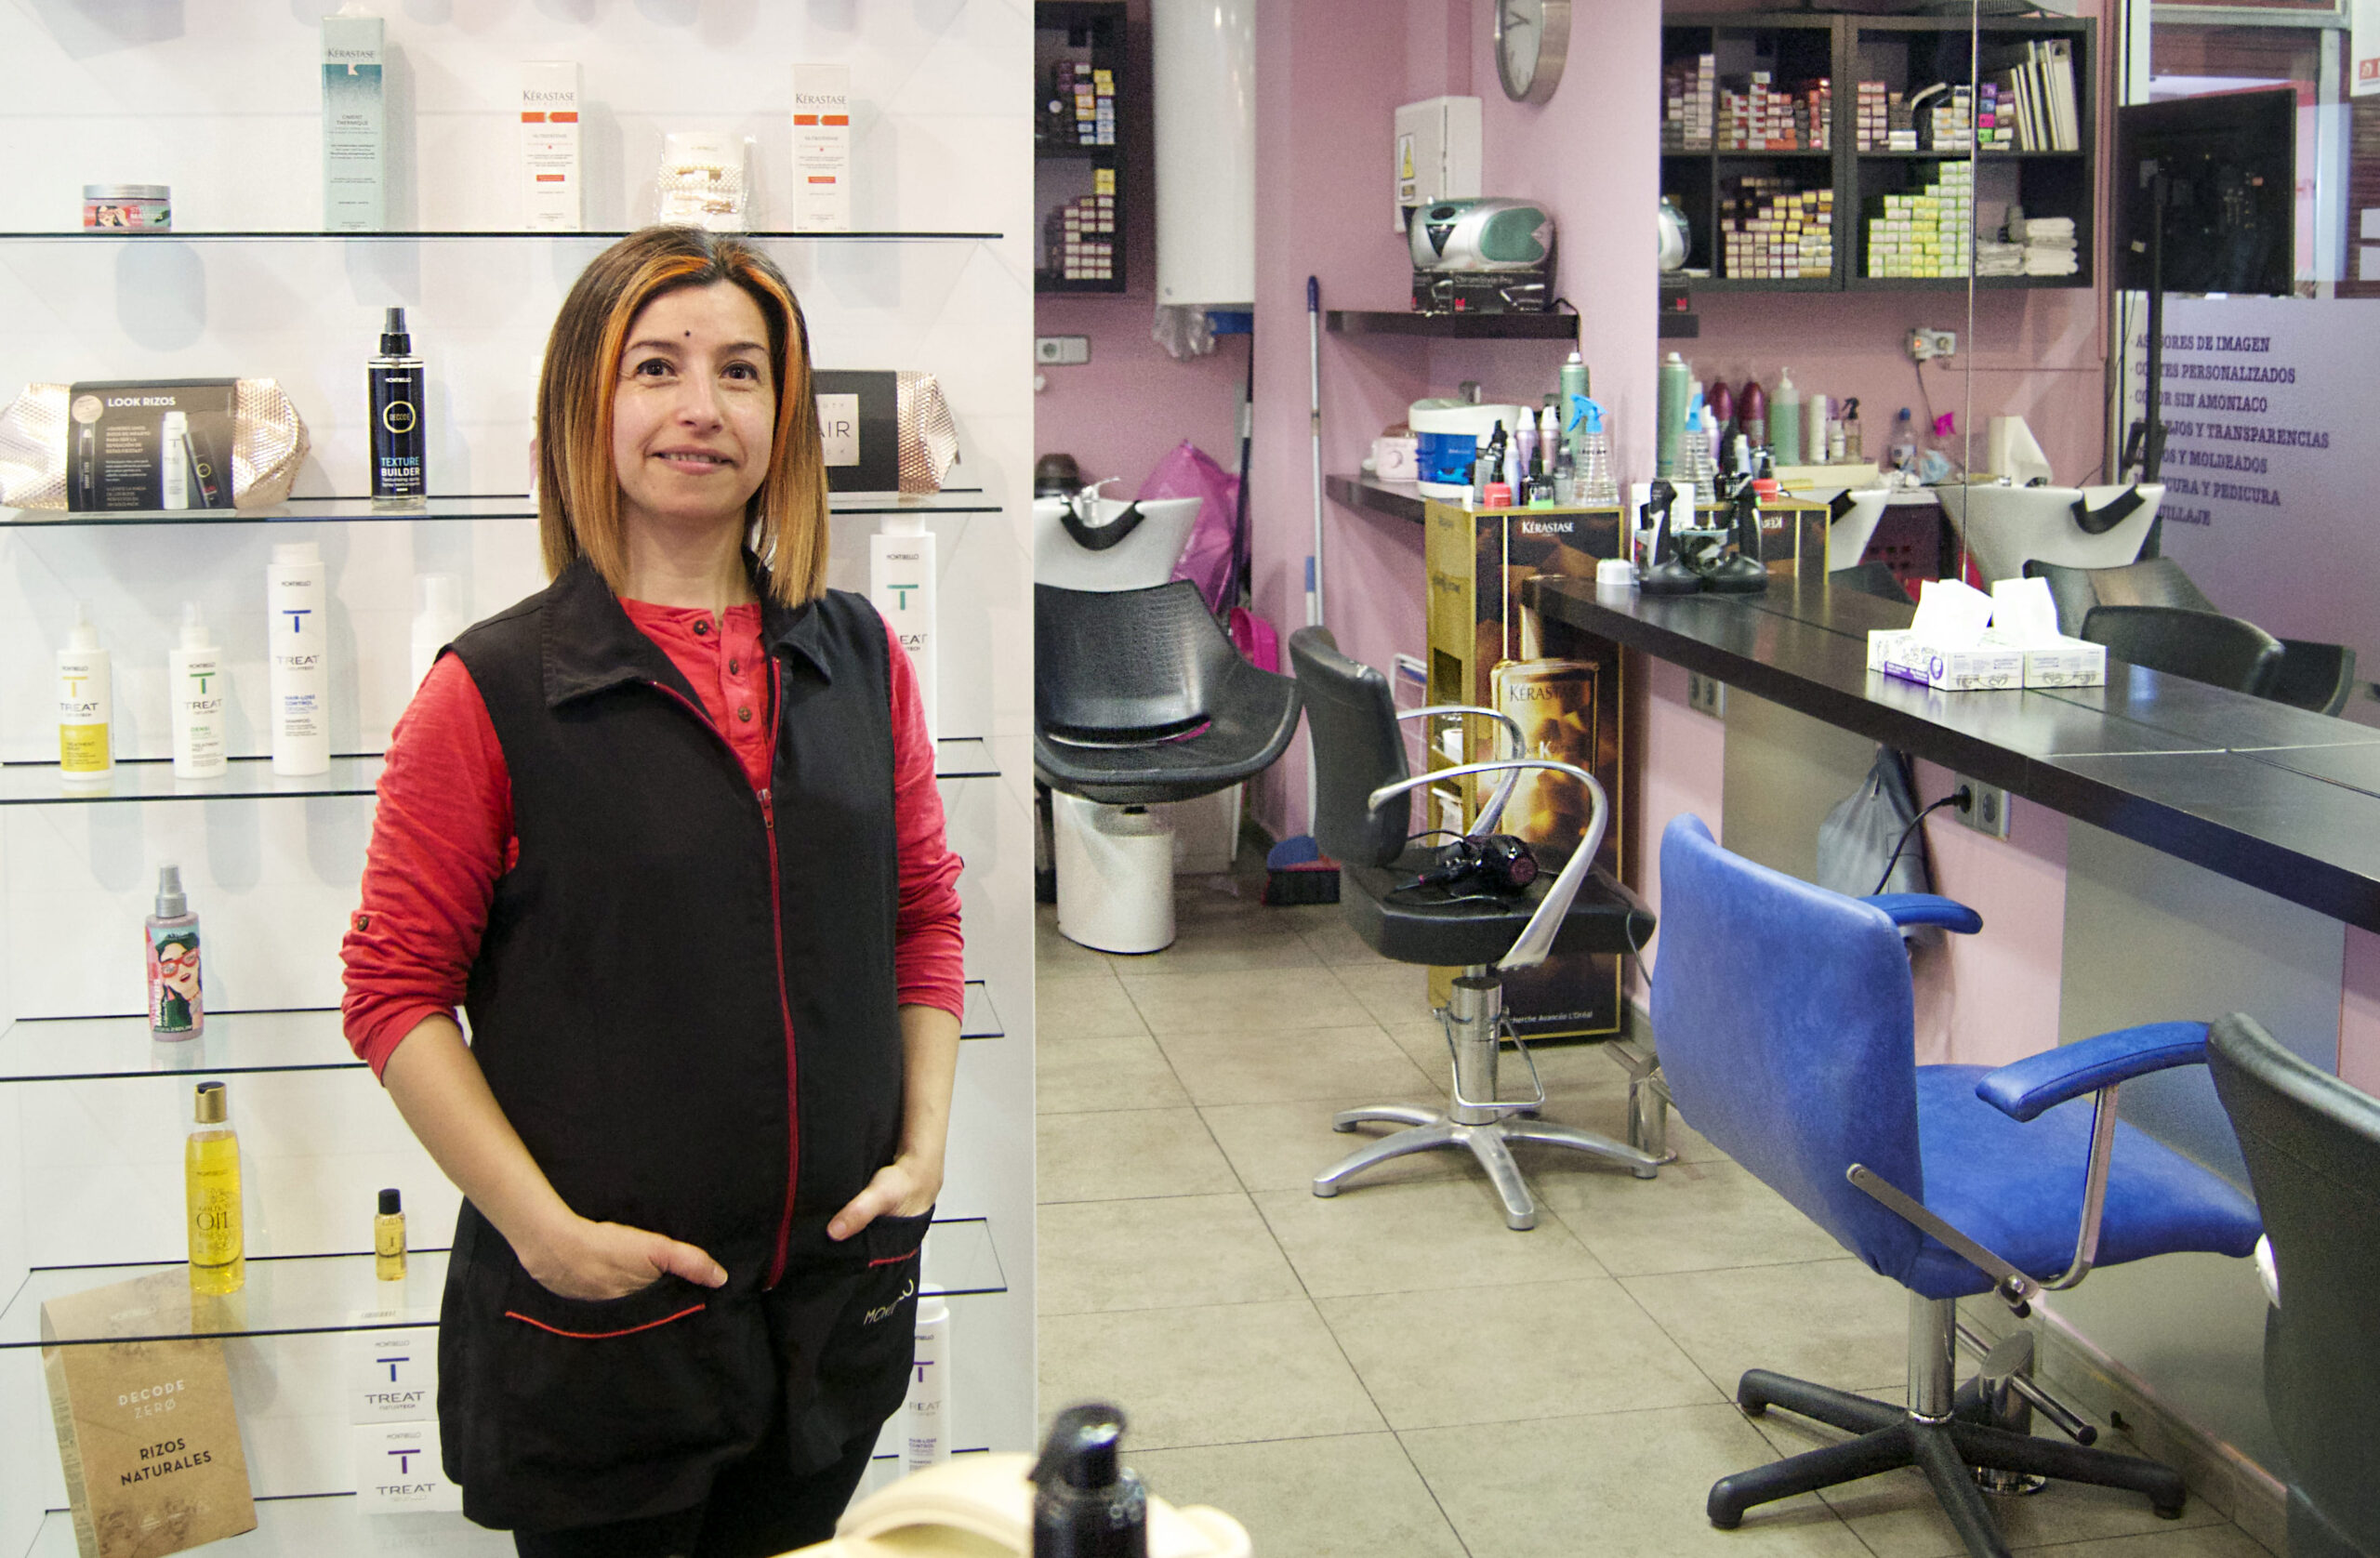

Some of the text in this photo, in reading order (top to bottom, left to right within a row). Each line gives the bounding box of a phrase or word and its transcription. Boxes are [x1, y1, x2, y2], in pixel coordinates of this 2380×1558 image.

[2196, 336, 2214, 350] DE
[2216, 337, 2270, 352] IMAGEN
[2181, 363, 2295, 384] PERSONALIZADOS
[108, 396, 176, 407] LOOK RIZOS
[2175, 392, 2195, 407] SIN
[2197, 394, 2268, 412] AMONIACO
[2196, 423, 2204, 438] Y
[2207, 423, 2330, 448] TRANSPARENCIAS
[381, 456, 420, 467] TEXTURE
[2178, 450, 2187, 465] Y
[2189, 450, 2268, 474] MOLDEADOS
[381, 467, 420, 477] BUILDER
[2202, 481, 2211, 496] Y
[2214, 482, 2281, 506] PEDICURA
[1522, 521, 1575, 534] KÉRASTASE
[276, 654, 320, 665] TREAT
[60, 702, 99, 712] TREAT
[184, 698, 223, 710] TREAT
[118, 1380, 185, 1406] DECODE
[364, 1391, 426, 1405] TREAT
[139, 1438, 186, 1460] RIZOS
[120, 1450, 212, 1486] NATURALES
[376, 1483, 436, 1496] TREAT
